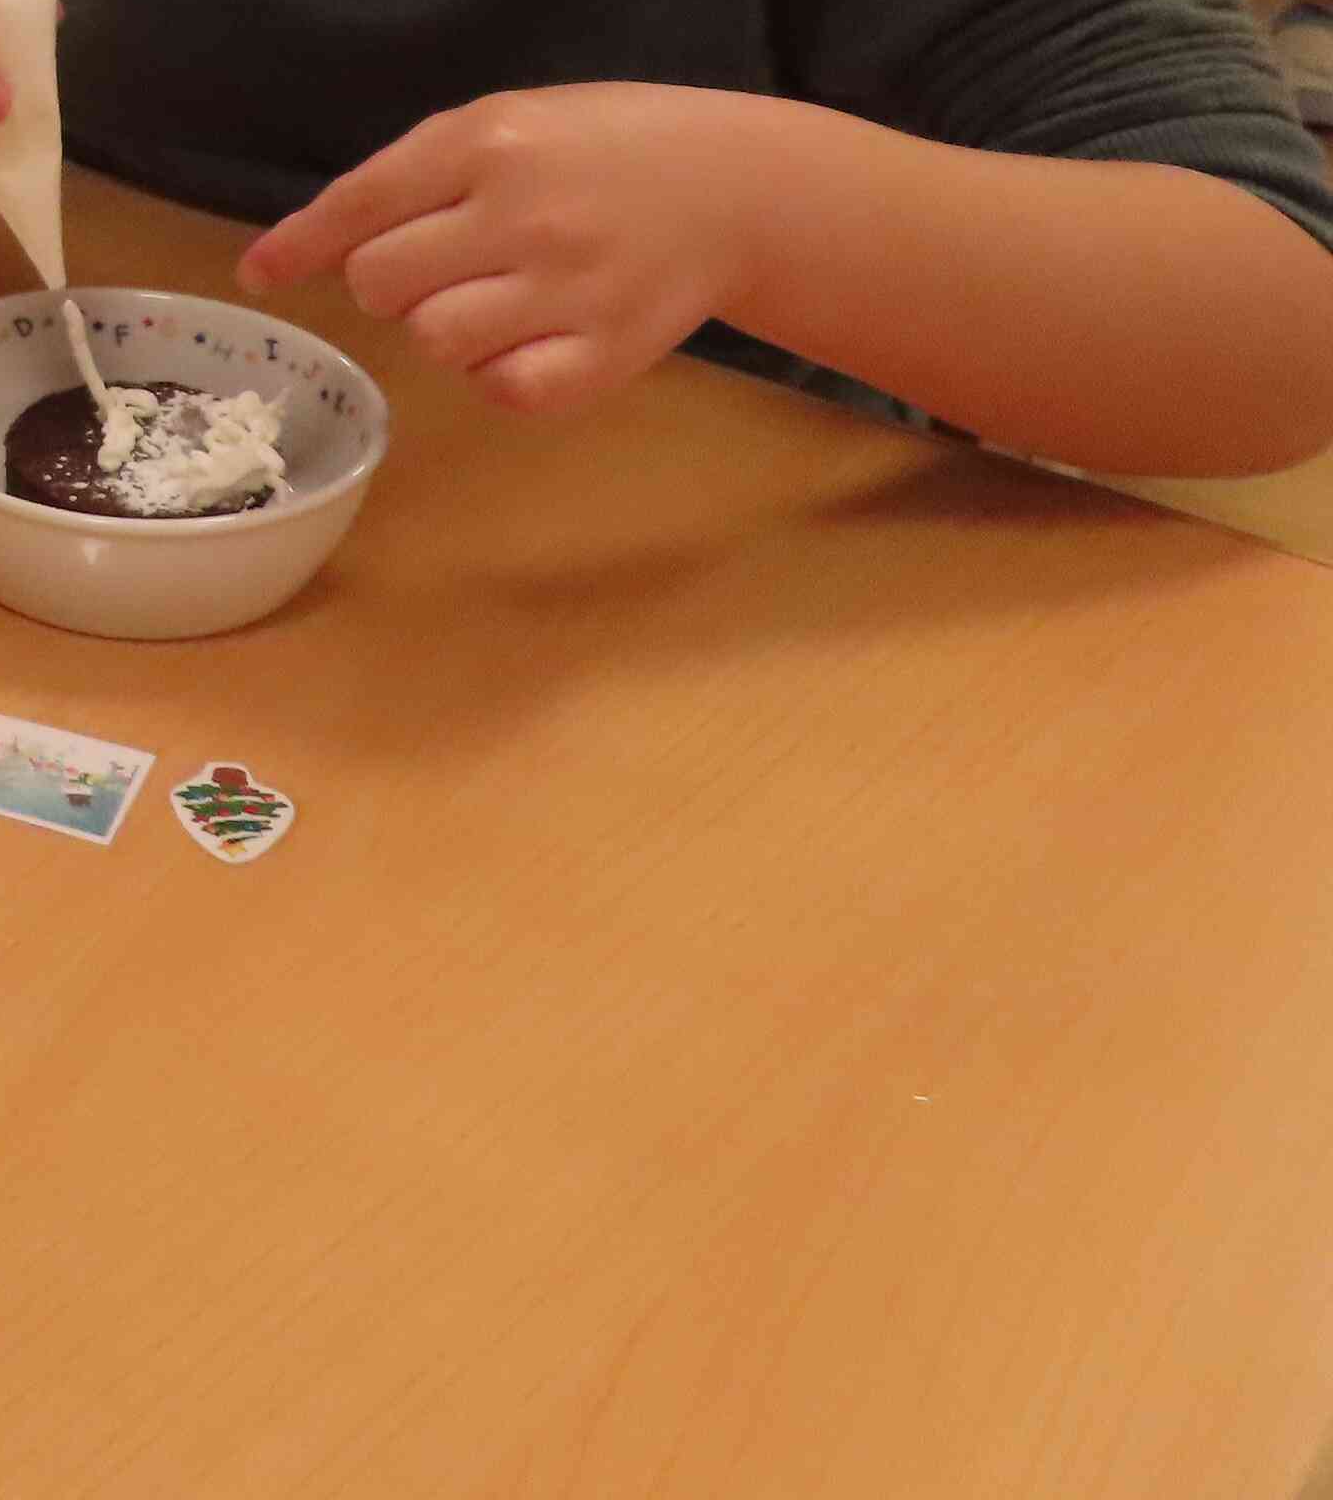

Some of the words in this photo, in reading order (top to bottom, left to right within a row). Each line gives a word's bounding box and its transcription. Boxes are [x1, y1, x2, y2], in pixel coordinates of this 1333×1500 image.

[13, 316, 34, 338] D
[115, 324, 129, 348] F
[265, 338, 279, 360] I
